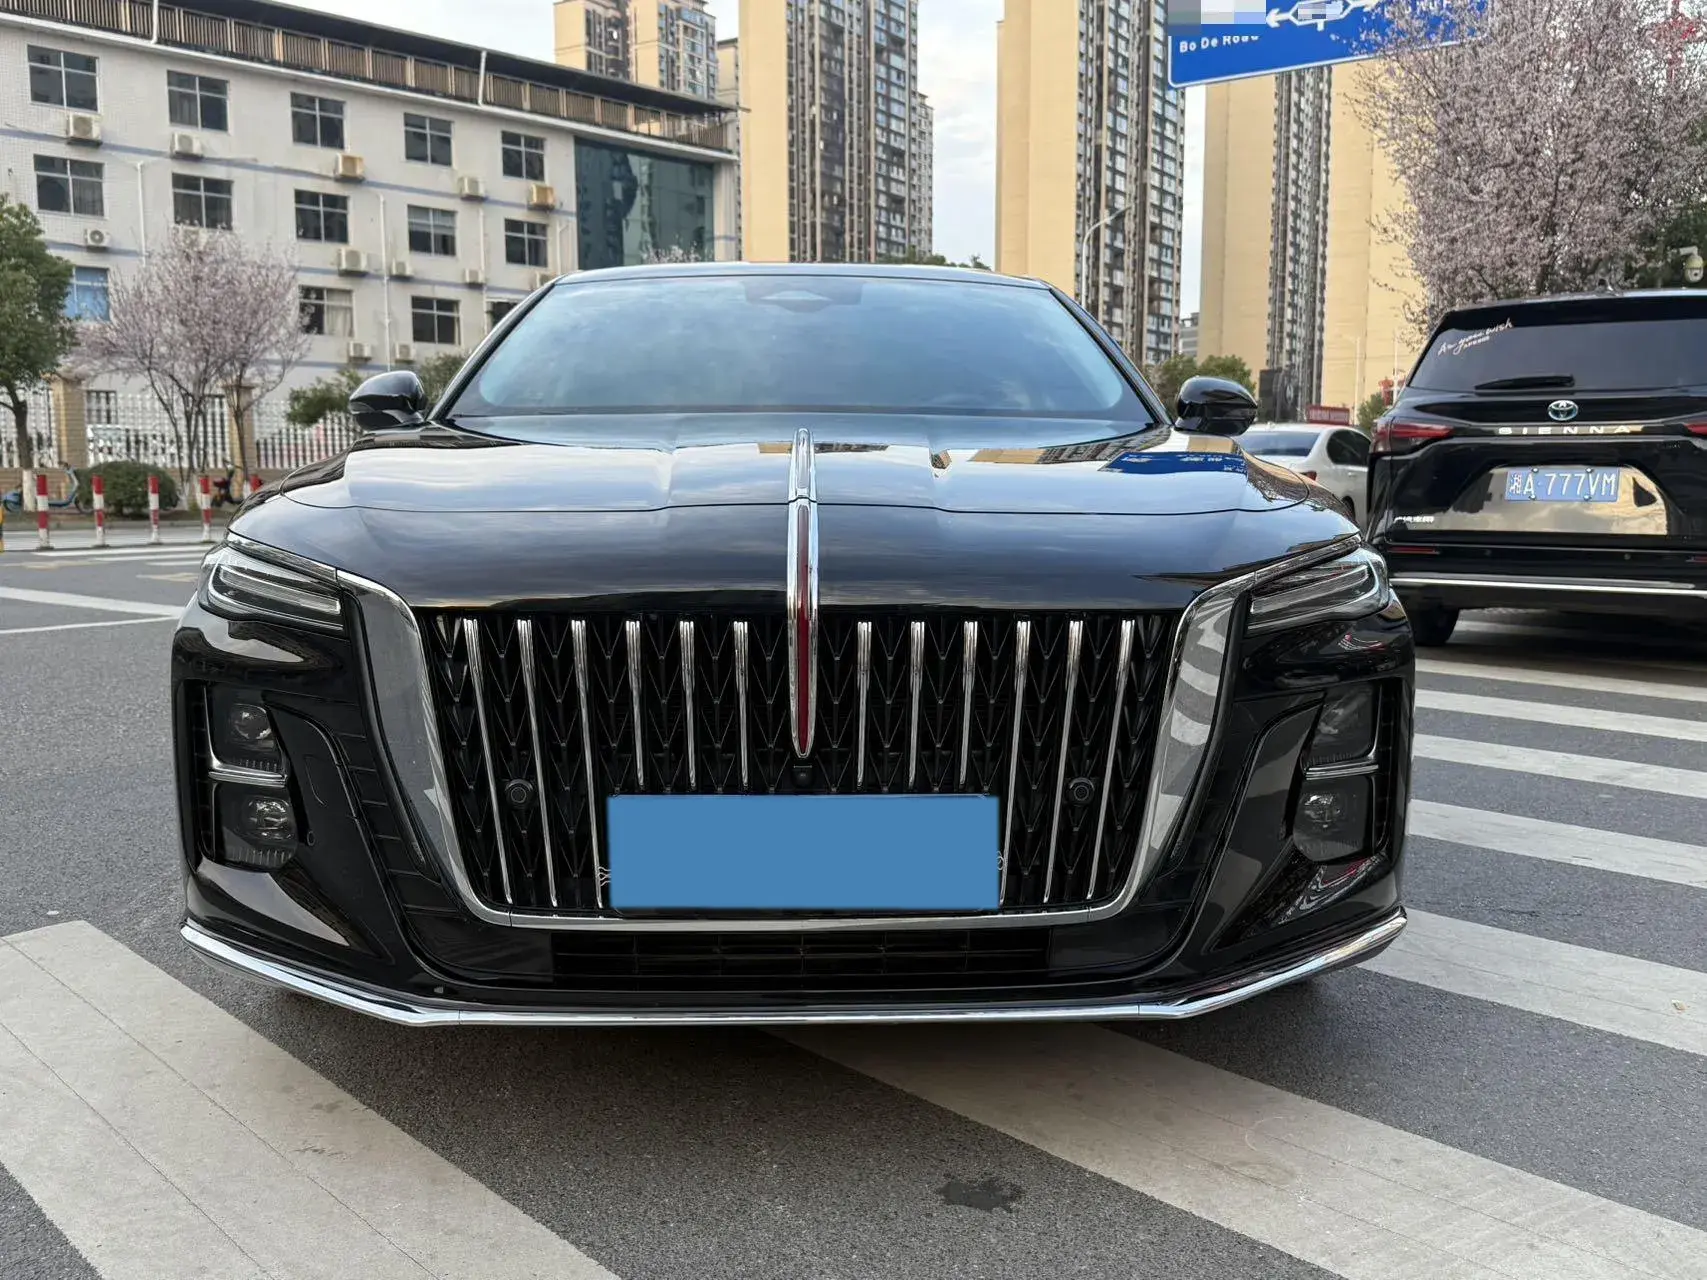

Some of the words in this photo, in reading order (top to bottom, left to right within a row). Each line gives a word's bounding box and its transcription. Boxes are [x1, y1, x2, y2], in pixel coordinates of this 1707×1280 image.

[1180, 41, 1197, 53] Bo
[1200, 37, 1218, 49] De
[1498, 426, 1631, 435] SIENNA
